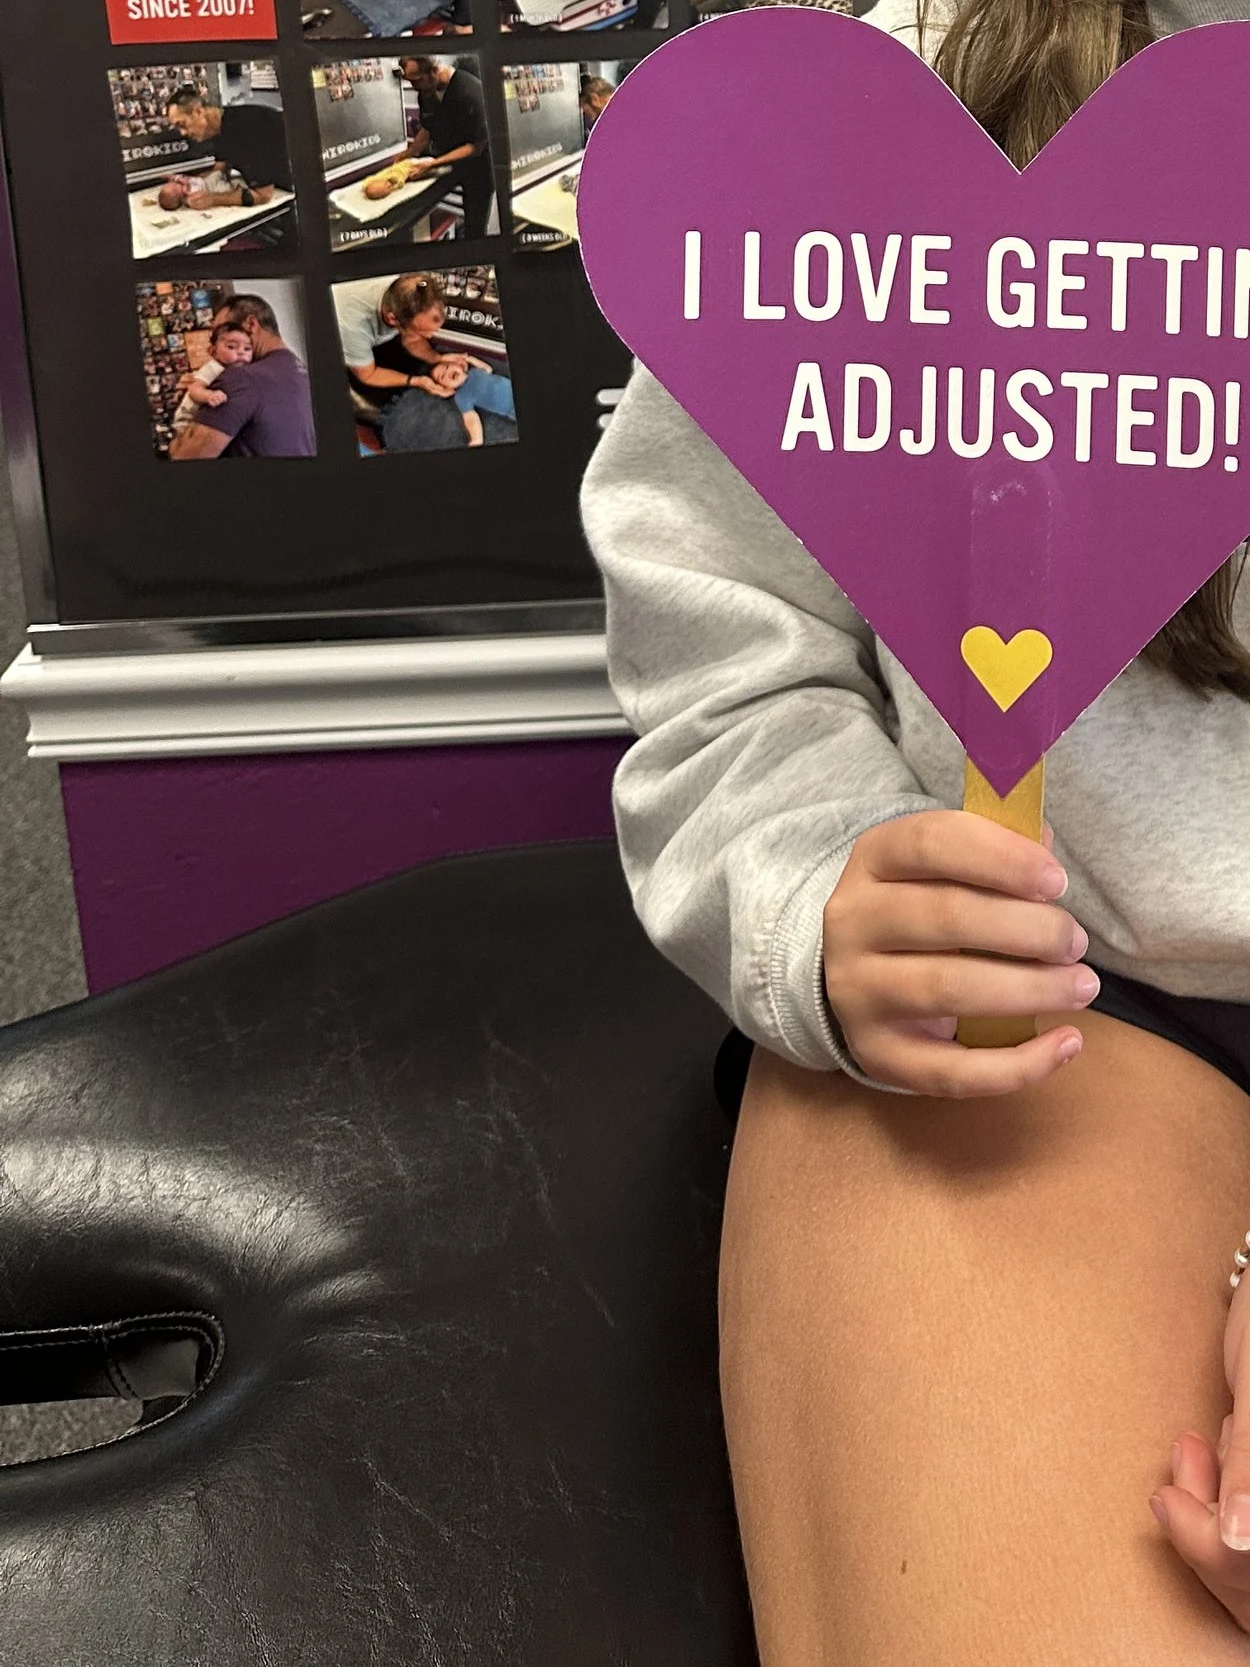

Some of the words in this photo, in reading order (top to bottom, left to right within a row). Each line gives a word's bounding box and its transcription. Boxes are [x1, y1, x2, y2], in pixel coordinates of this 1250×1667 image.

[684, 230, 701, 321] I
[742, 230, 953, 326] LOVE
[780, 361, 1241, 472] ADJUSTED!
